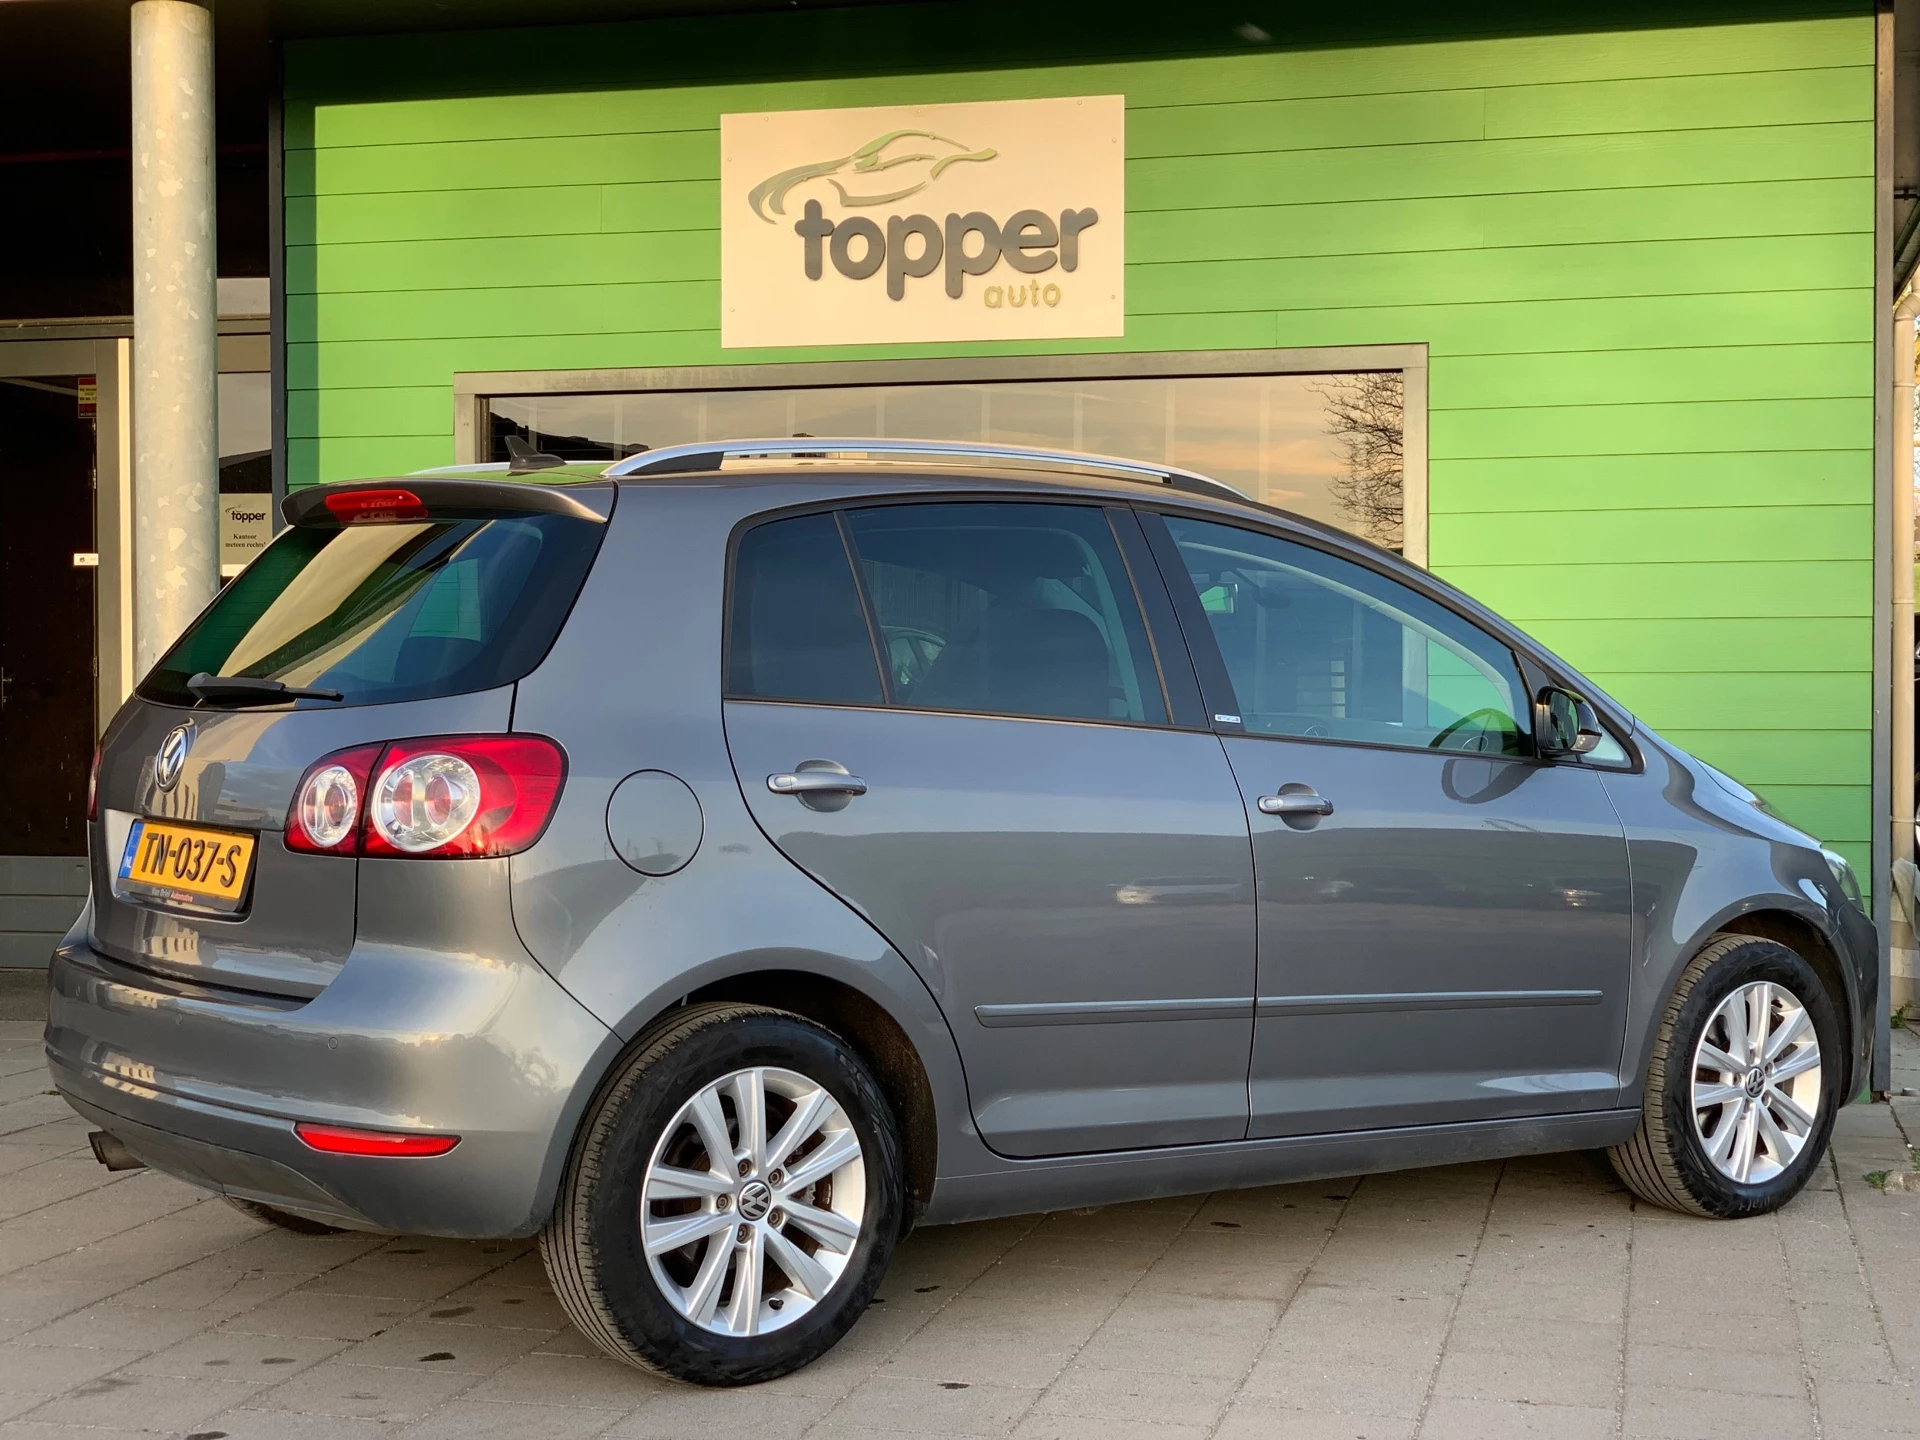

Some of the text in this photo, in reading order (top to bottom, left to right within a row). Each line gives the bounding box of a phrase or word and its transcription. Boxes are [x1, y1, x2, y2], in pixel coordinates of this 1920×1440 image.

[794, 198, 1099, 301] topper
[984, 279, 1062, 308] auto
[231, 510, 266, 523] topper
[140, 832, 242, 888] TN-037-S
